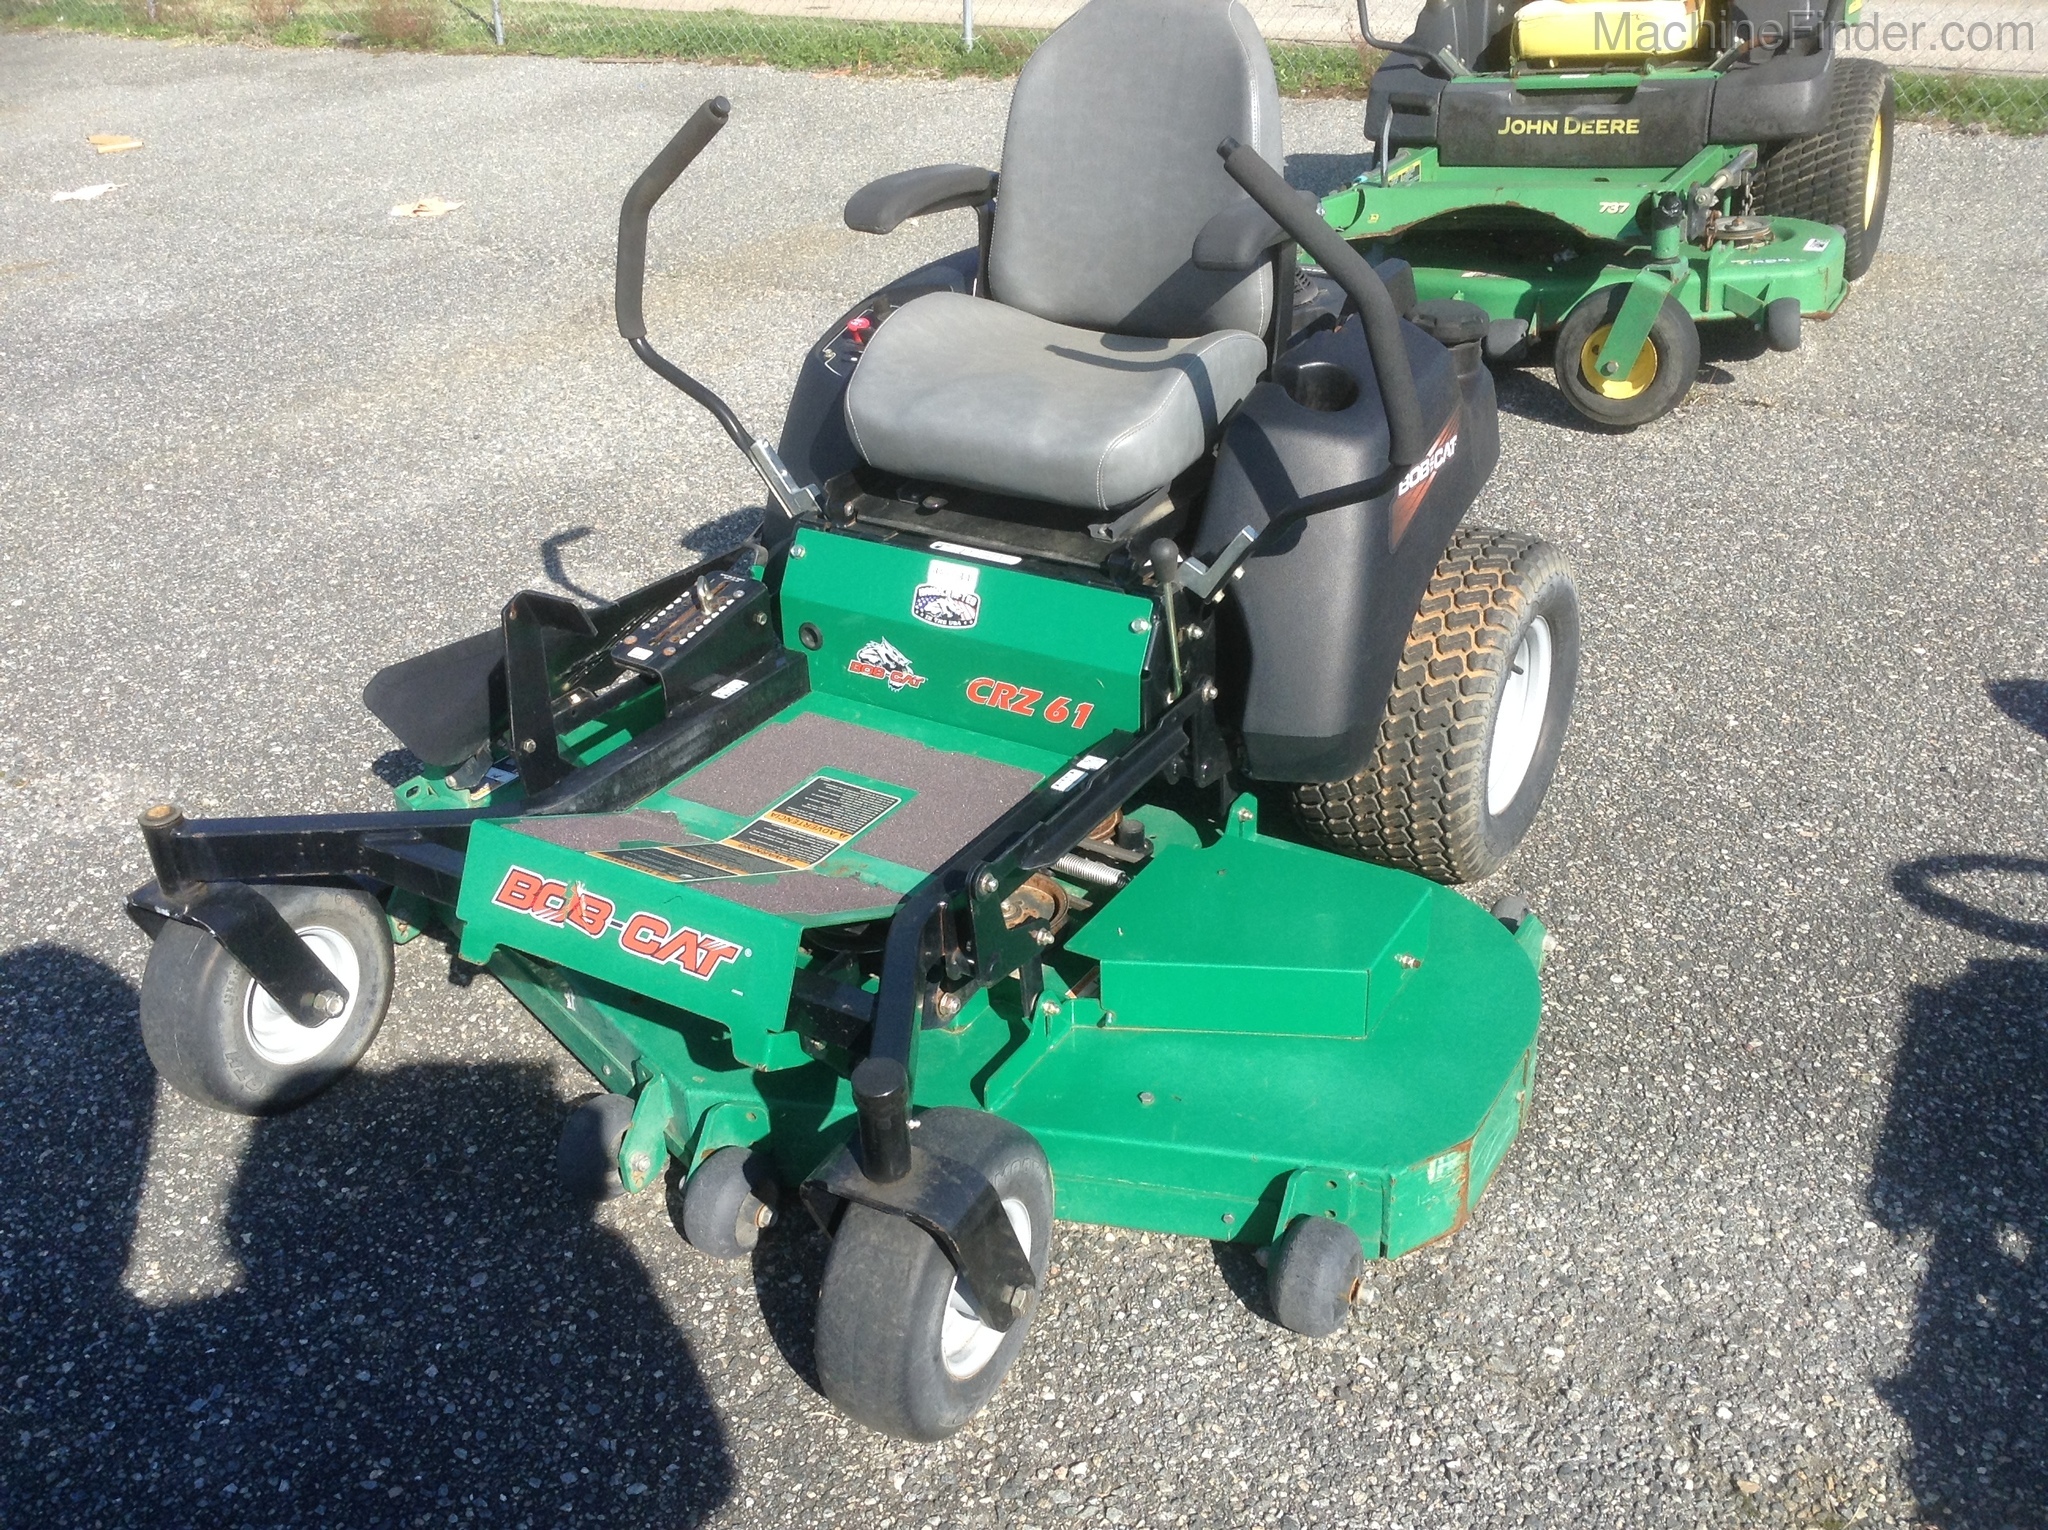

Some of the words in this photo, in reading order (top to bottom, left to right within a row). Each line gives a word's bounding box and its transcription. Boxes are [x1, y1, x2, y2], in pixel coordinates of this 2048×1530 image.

[1498, 116, 1558, 135] JOHN
[1563, 116, 1640, 135] DEERE
[1598, 201, 1630, 214] 737
[965, 676, 1043, 717] CRZ
[1043, 696, 1095, 730] 61
[769, 811, 839, 836] ADVERTENCIA
